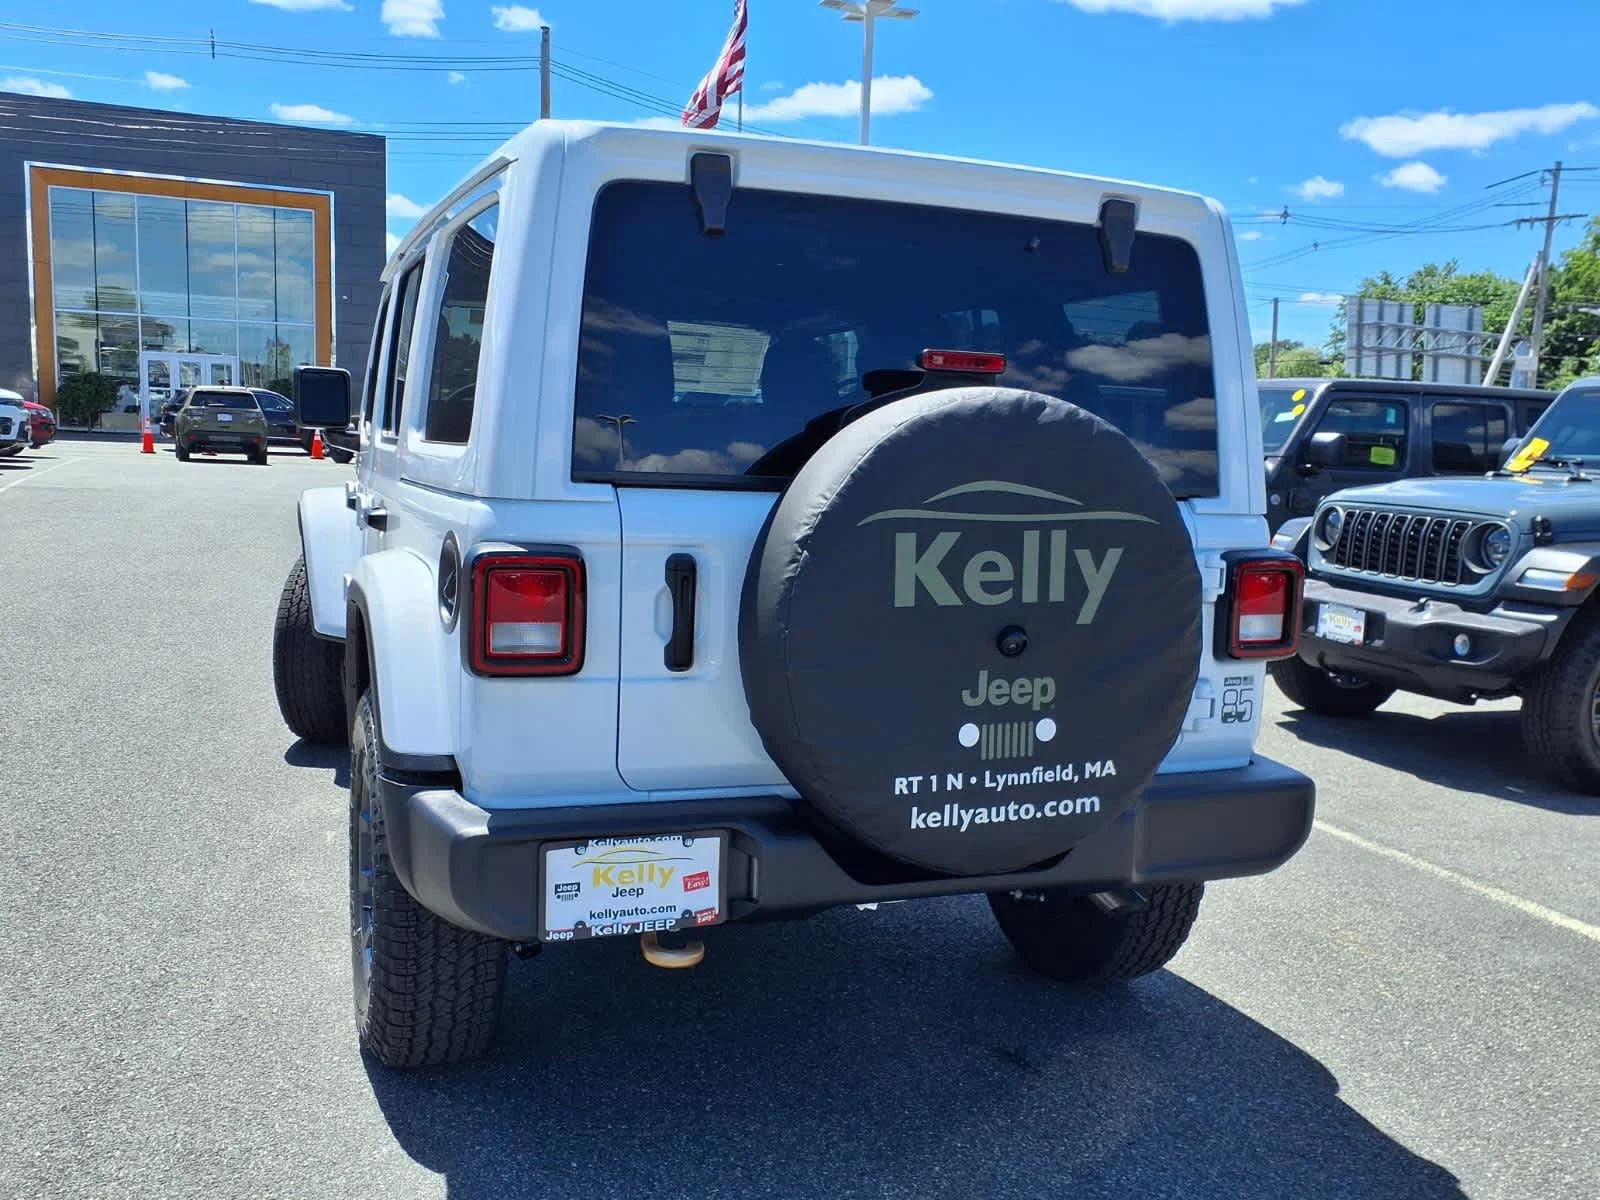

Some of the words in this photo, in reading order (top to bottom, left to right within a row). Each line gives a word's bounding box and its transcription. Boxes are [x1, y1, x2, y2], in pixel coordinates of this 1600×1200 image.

[894, 529, 1125, 625] Kelly
[961, 670, 1056, 711] Jeep
[894, 776, 923, 796] RT
[930, 774, 938, 793] 1
[946, 773, 964, 791] N
[984, 763, 1079, 792] Lynnfield,
[1084, 759, 1117, 779] MA
[910, 795, 1101, 833] kellyauto.com
[592, 862, 676, 889] Kelly
[556, 883, 579, 893] Jeep
[611, 885, 645, 899] Jeep
[588, 903, 677, 921] kellyauto.com
[546, 929, 574, 941] Jeep
[590, 923, 632, 937] Kelly
[633, 918, 677, 934] JEEP
